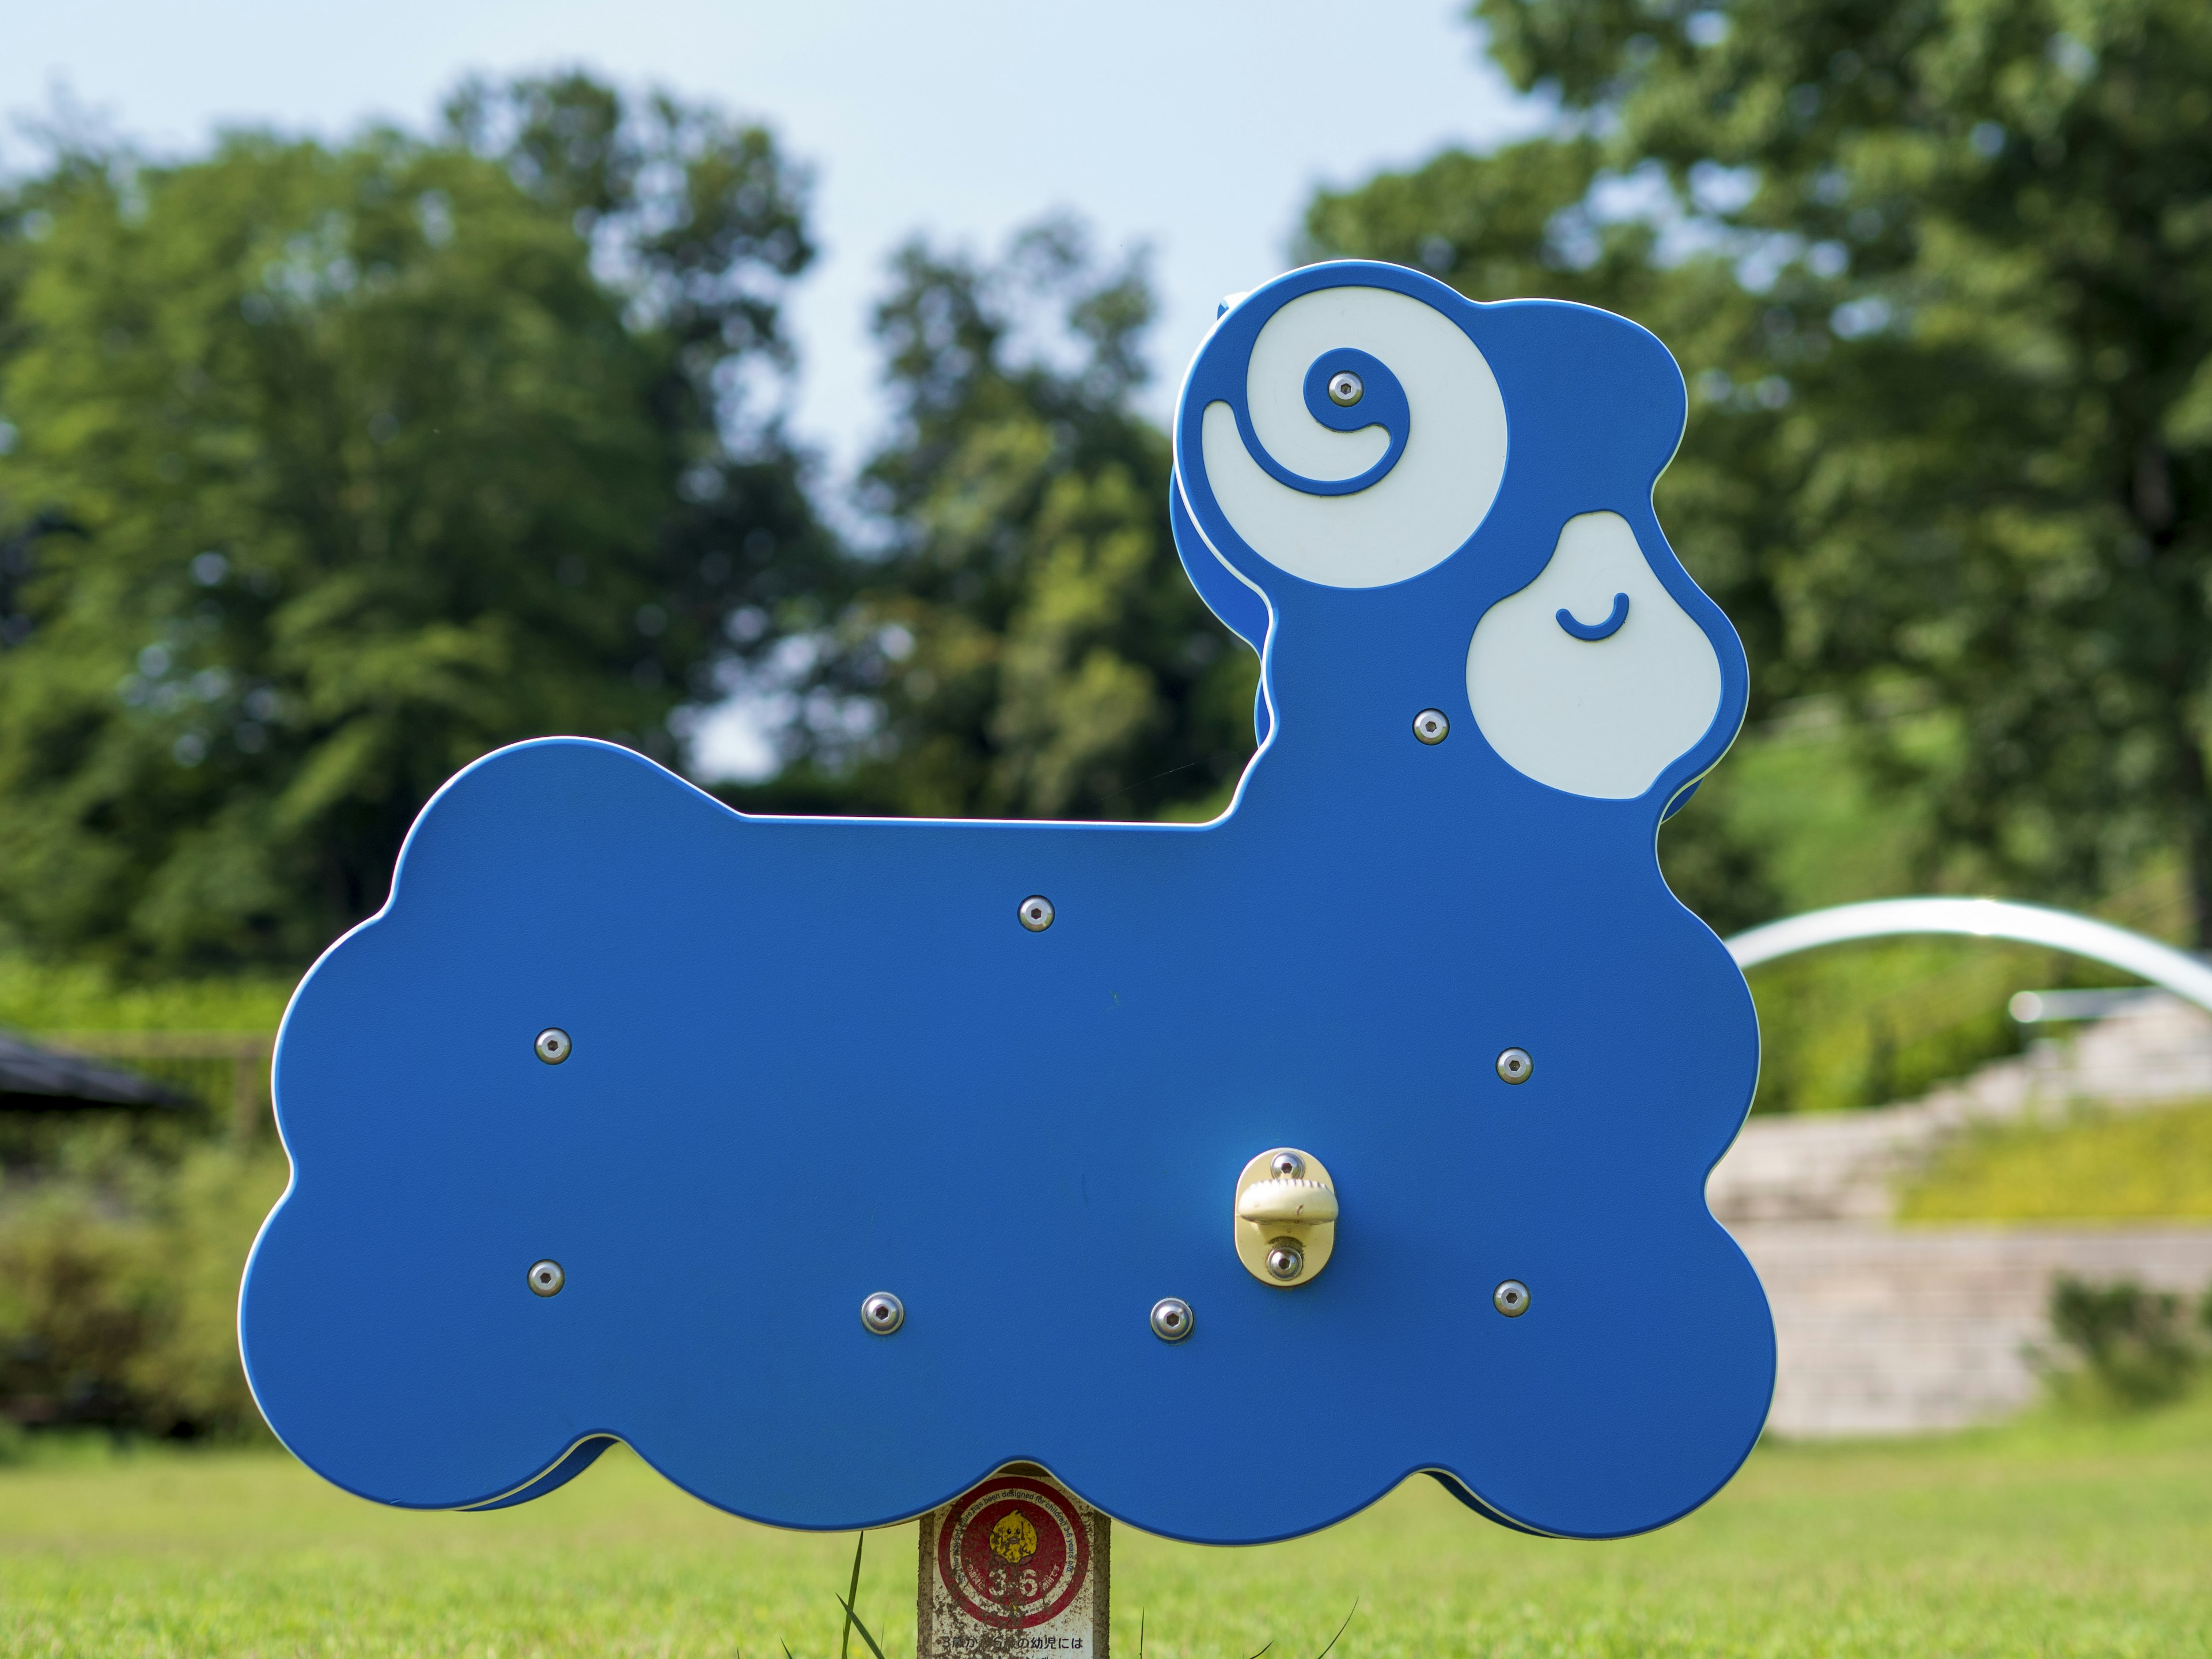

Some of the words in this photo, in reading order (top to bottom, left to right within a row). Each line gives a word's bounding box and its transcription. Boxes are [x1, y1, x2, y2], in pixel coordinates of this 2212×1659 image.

[970, 1501, 983, 1513] has
[983, 1493, 1000, 1504] been
[1001, 1491, 1034, 1501] designed
[1034, 1495, 1045, 1505] for
[1044, 1501, 1067, 1525] children
[1063, 1525, 1073, 1537] 3-6
[942, 1636, 1083, 1649] 3歳か6歳の幼児には
